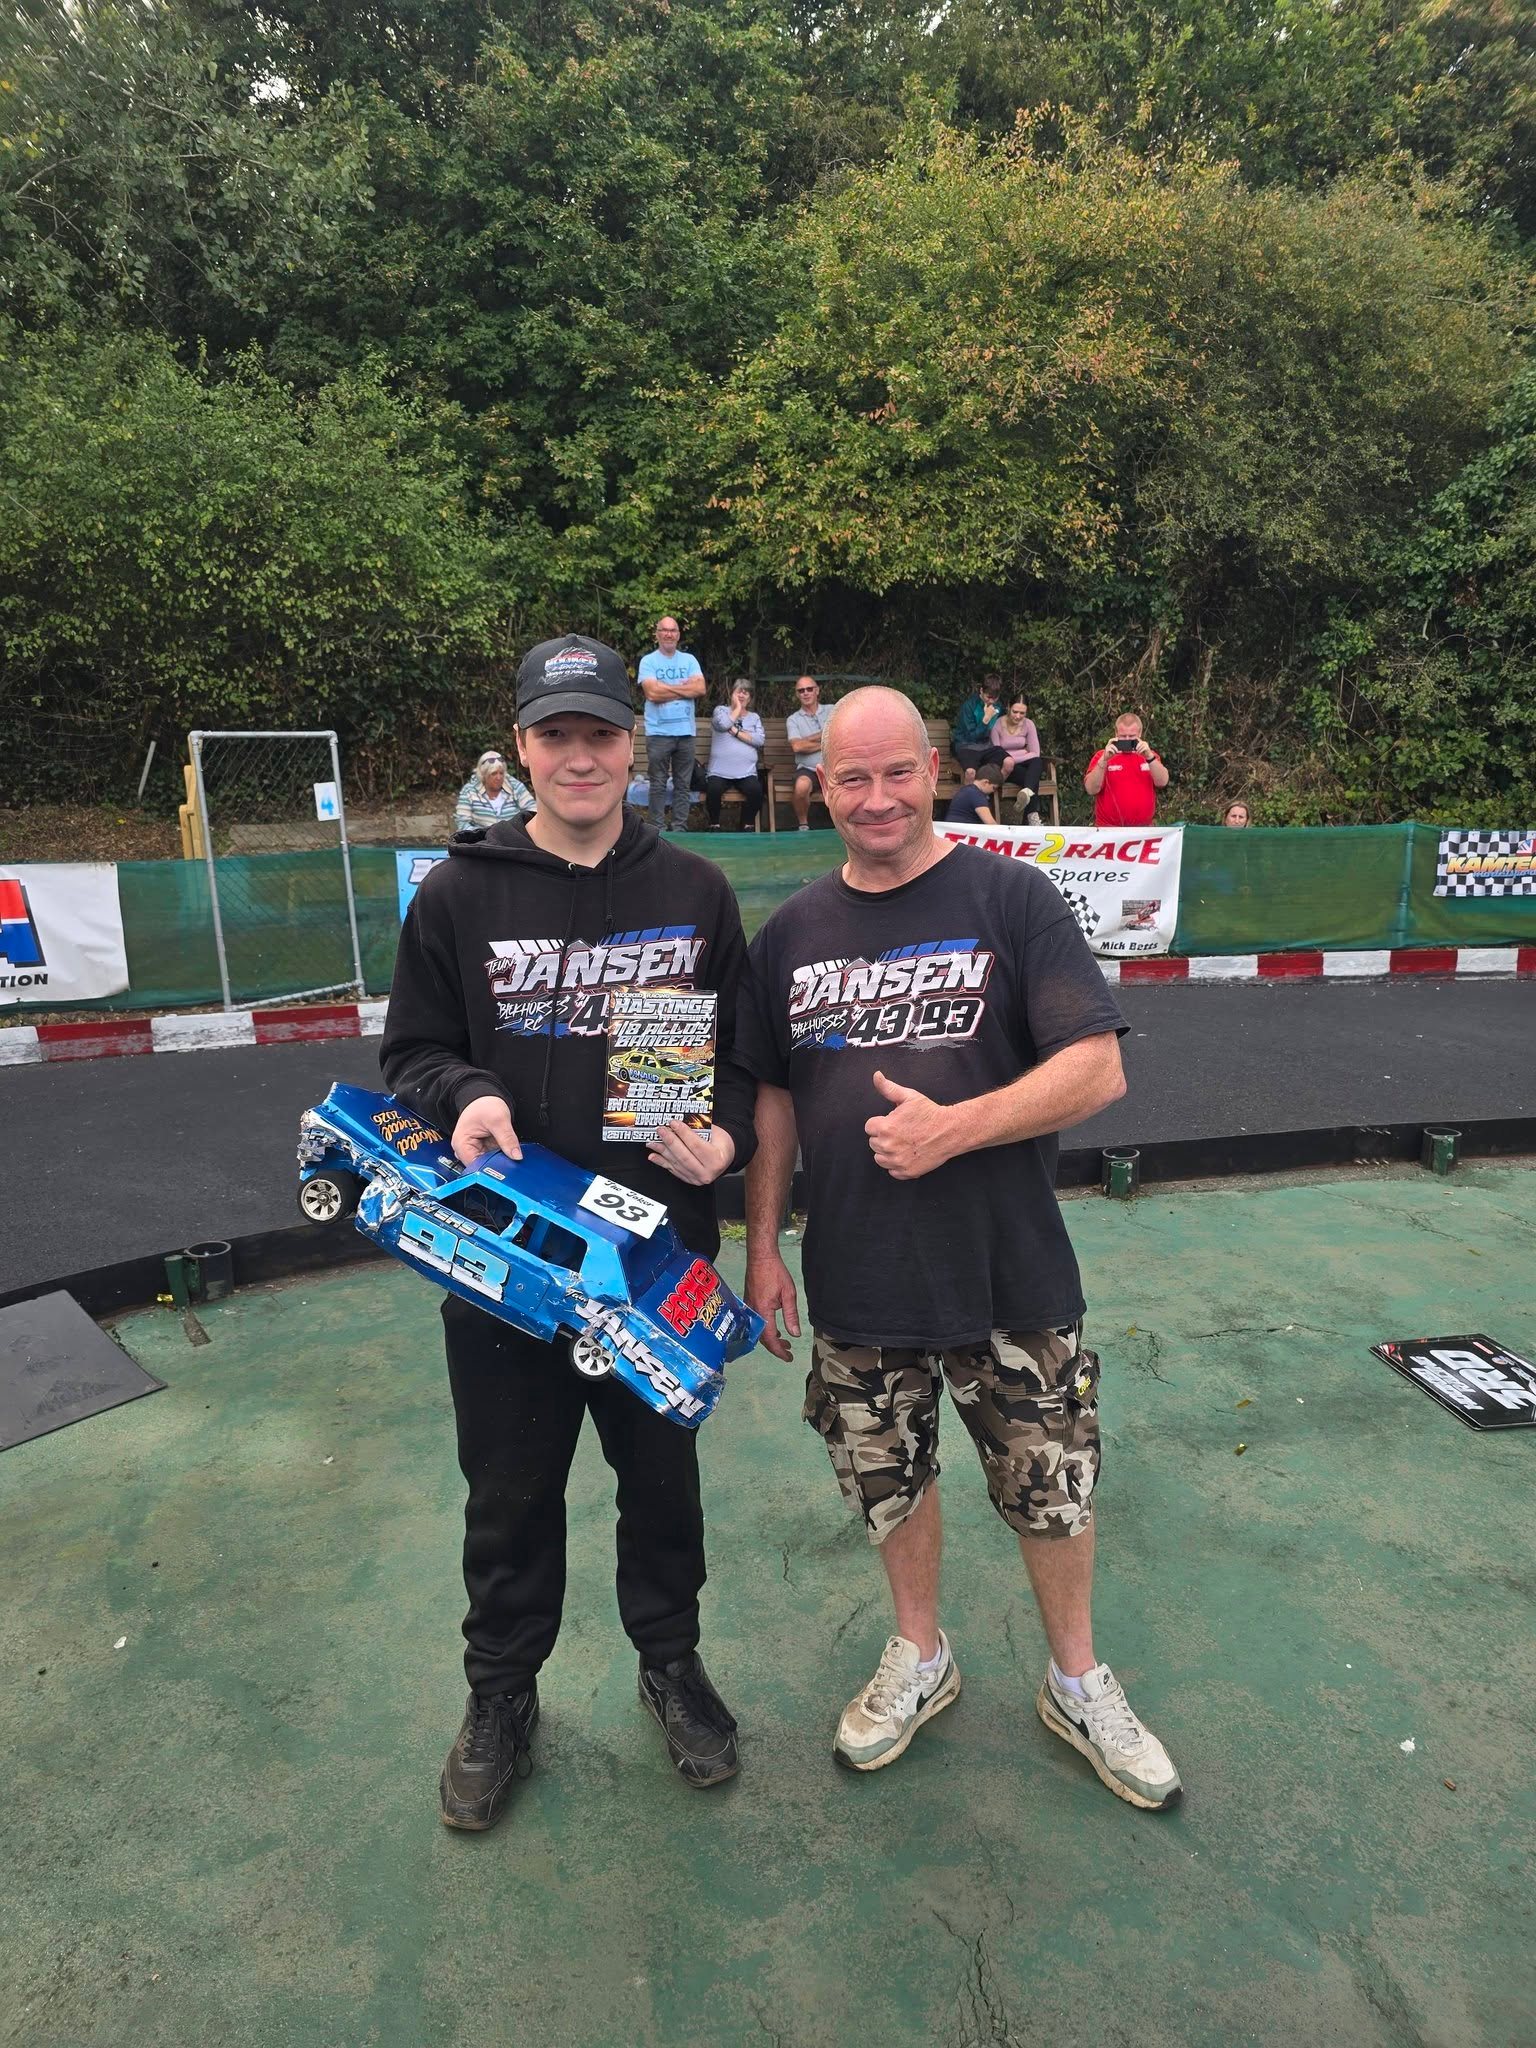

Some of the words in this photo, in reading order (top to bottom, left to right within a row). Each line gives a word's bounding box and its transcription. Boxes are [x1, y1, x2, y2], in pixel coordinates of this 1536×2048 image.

[656, 668, 687, 680] GOLF
[1049, 868, 1131, 886] Spares
[1099, 941, 1125, 951] Mick
[1128, 941, 1159, 951] Betts
[485, 958, 515, 977] TEUN
[493, 939, 705, 996] JANSEN
[789, 951, 993, 1018] JANSEN
[613, 998, 715, 1014] HASTINGS
[523, 1015, 544, 1031] RC
[569, 993, 609, 1037] 4
[658, 1014, 714, 1022] RACEWAY
[917, 999, 985, 1040] 93
[613, 1020, 642, 1037] 1/8
[643, 1021, 712, 1036] ALLOY
[614, 1034, 711, 1048] BANGERS
[626, 1082, 697, 1099] BEST
[607, 1098, 711, 1114] INTERNATIONAL
[604, 1179, 622, 1192] The
[593, 1192, 650, 1224] 93
[397, 1210, 511, 1303] 93
[656, 1257, 722, 1338] HOOKED
[574, 1299, 706, 1419] JANSEN
